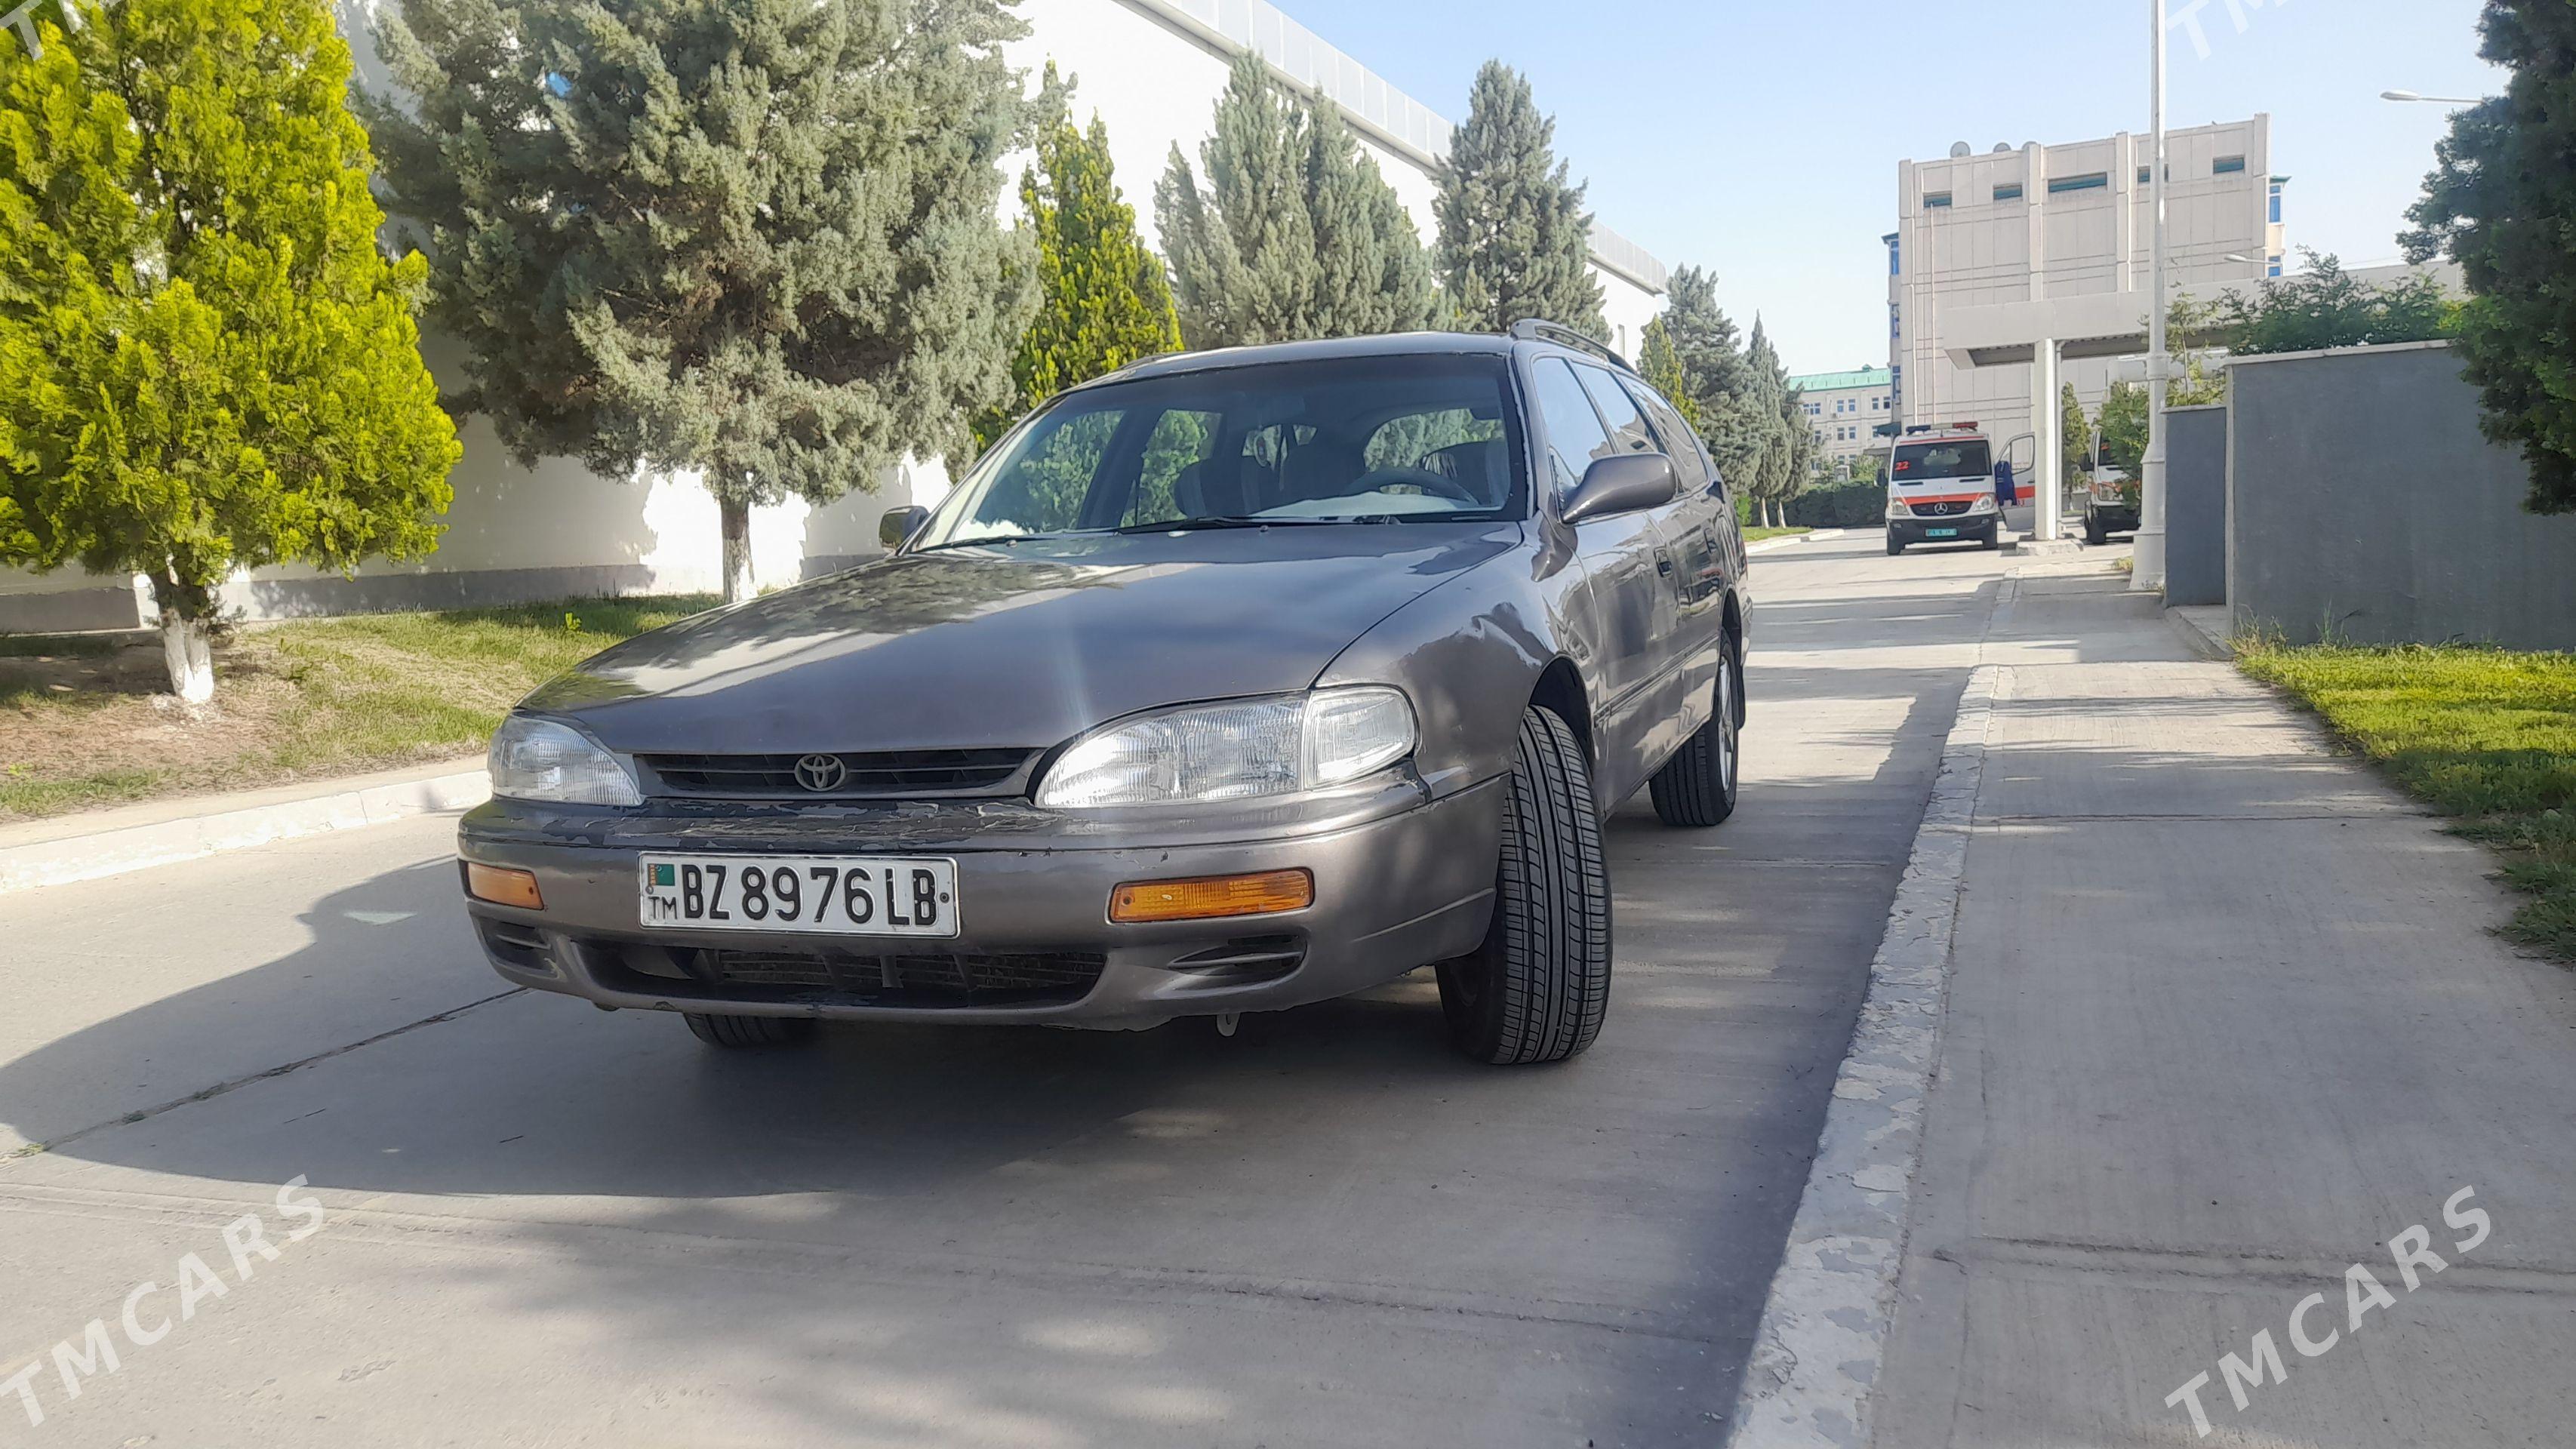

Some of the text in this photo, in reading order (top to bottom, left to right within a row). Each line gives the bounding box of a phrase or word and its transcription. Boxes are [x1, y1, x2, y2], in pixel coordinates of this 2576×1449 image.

[648, 896, 678, 920] TM
[682, 864, 937, 926] BZ 8976 LB
